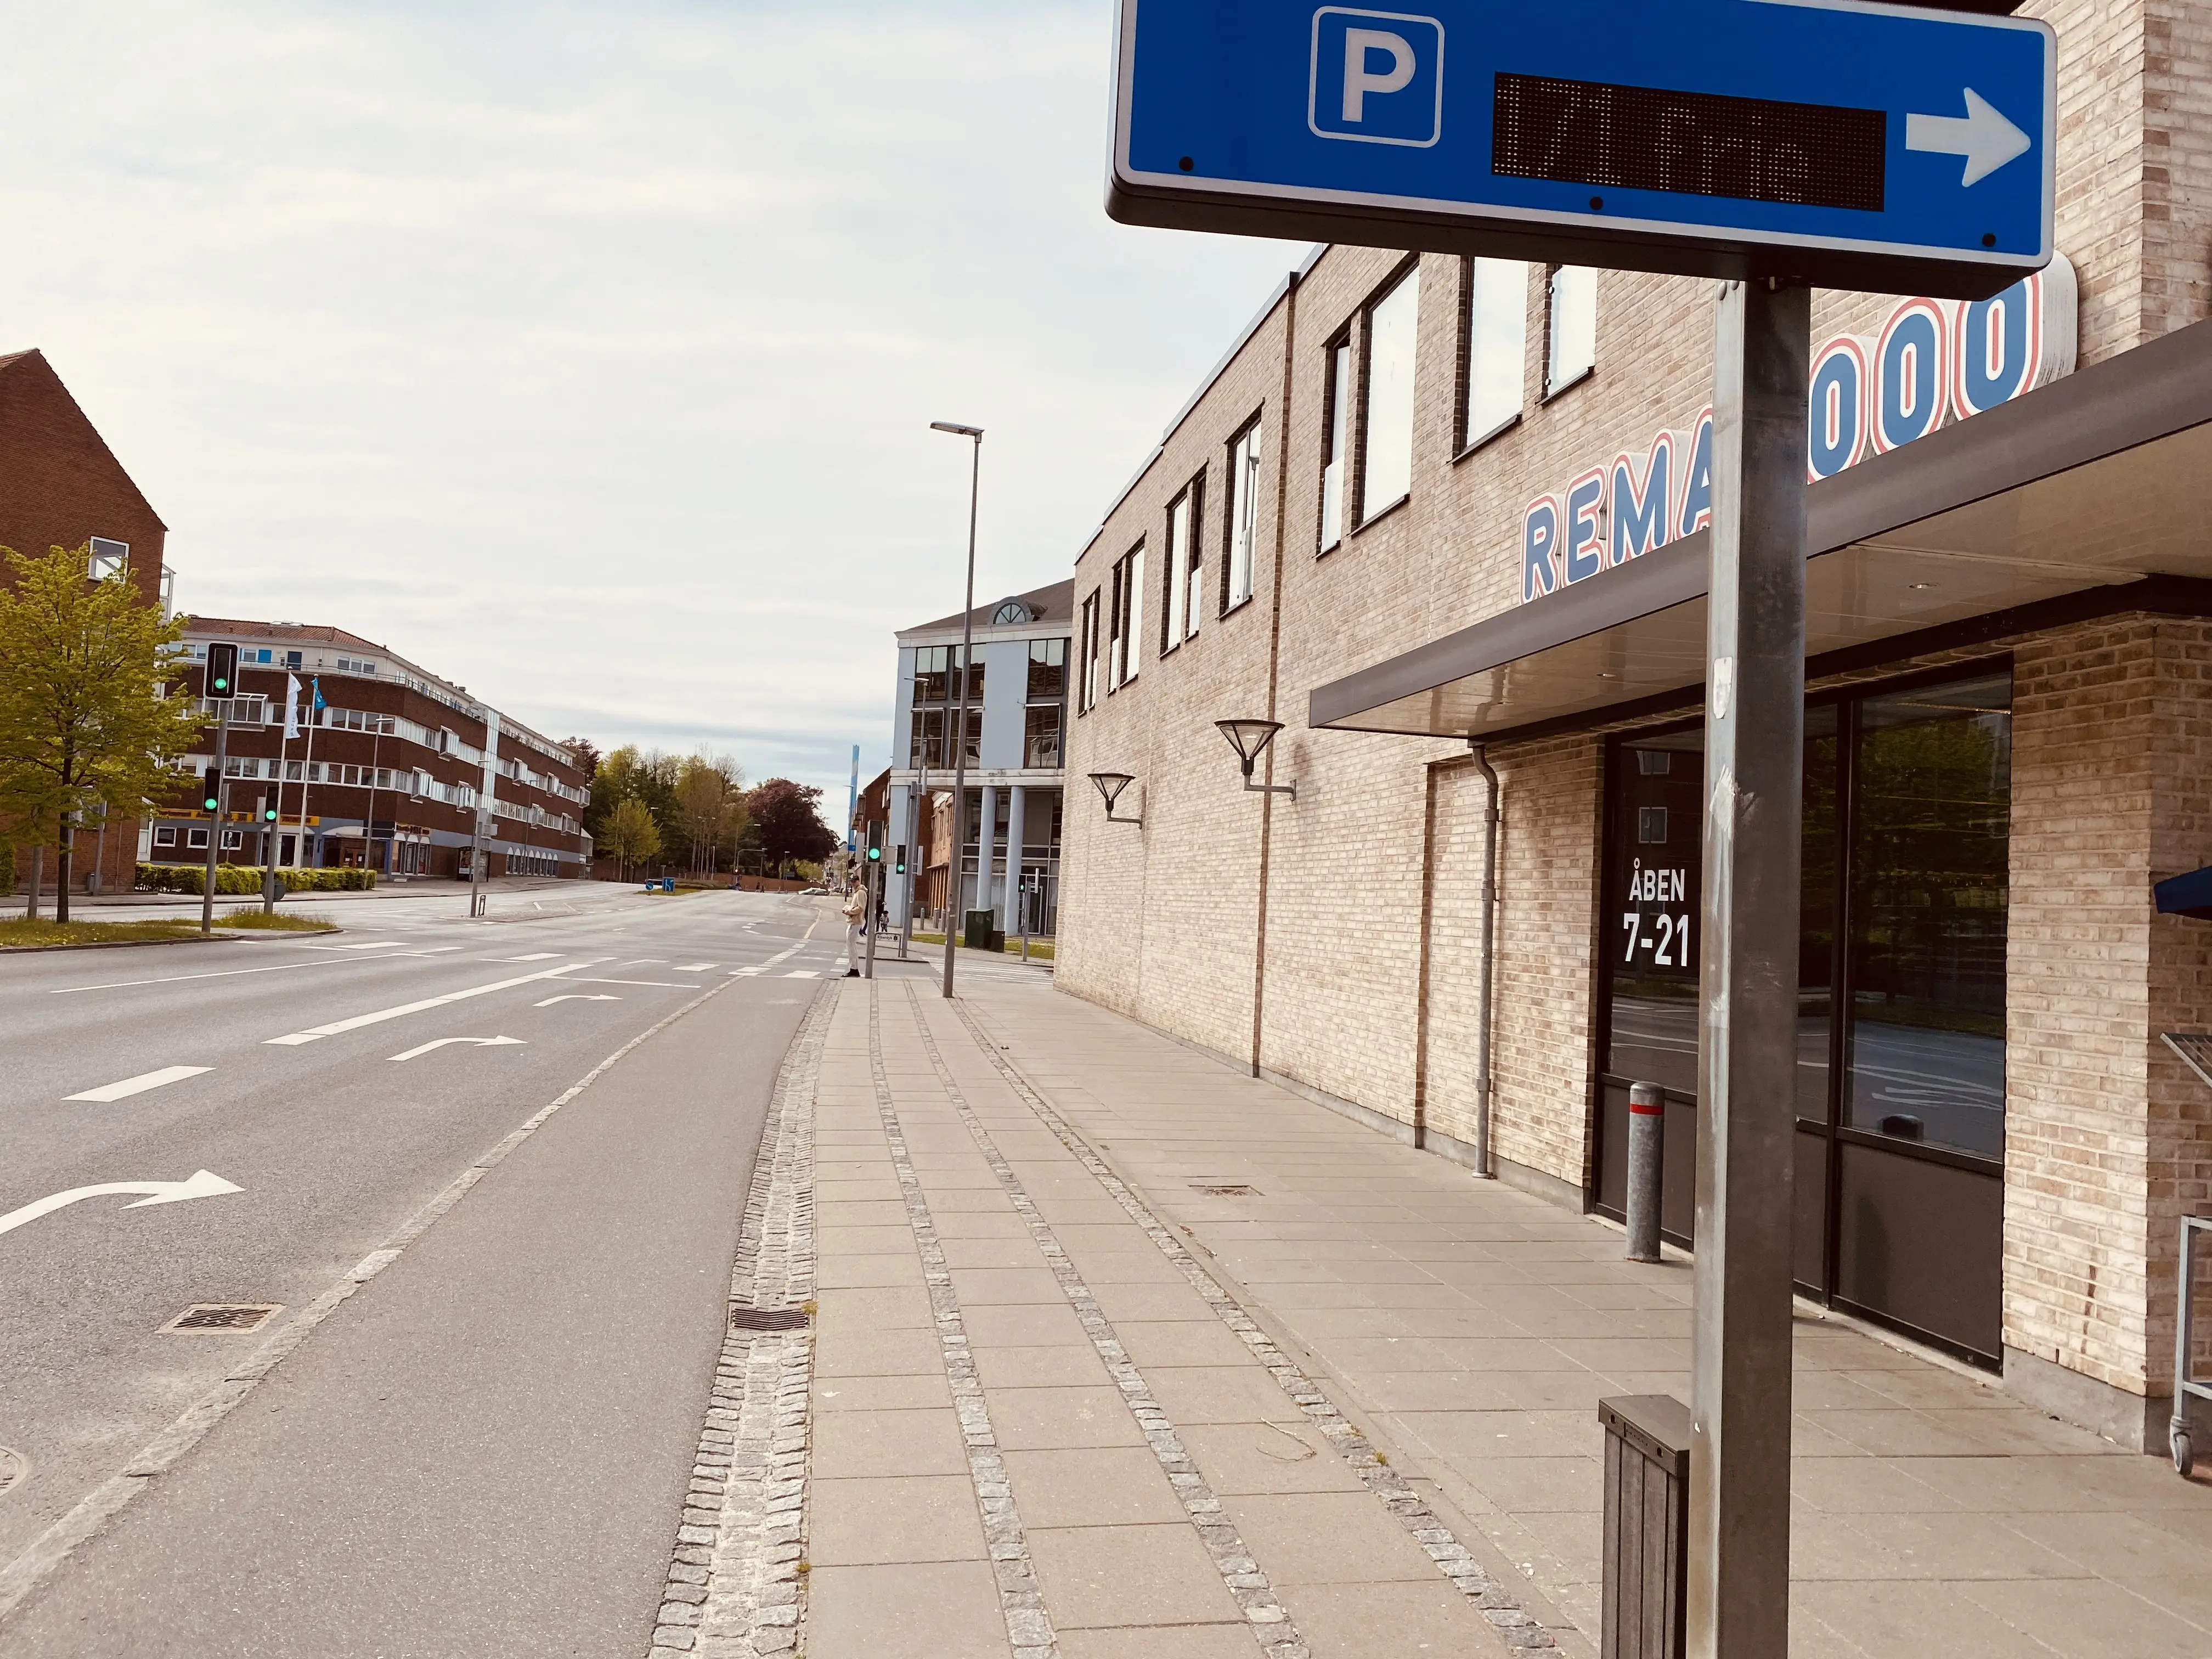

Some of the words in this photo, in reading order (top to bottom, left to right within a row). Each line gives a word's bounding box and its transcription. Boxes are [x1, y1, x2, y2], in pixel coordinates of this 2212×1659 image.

[1342, 27, 1416, 122] P
[1495, 78, 1621, 184] 171
[1521, 404, 1712, 605] REMA
[1808, 271, 2041, 485] 000
[1628, 857, 1685, 901] ÅBEN
[1623, 913, 1689, 967] 7-21
